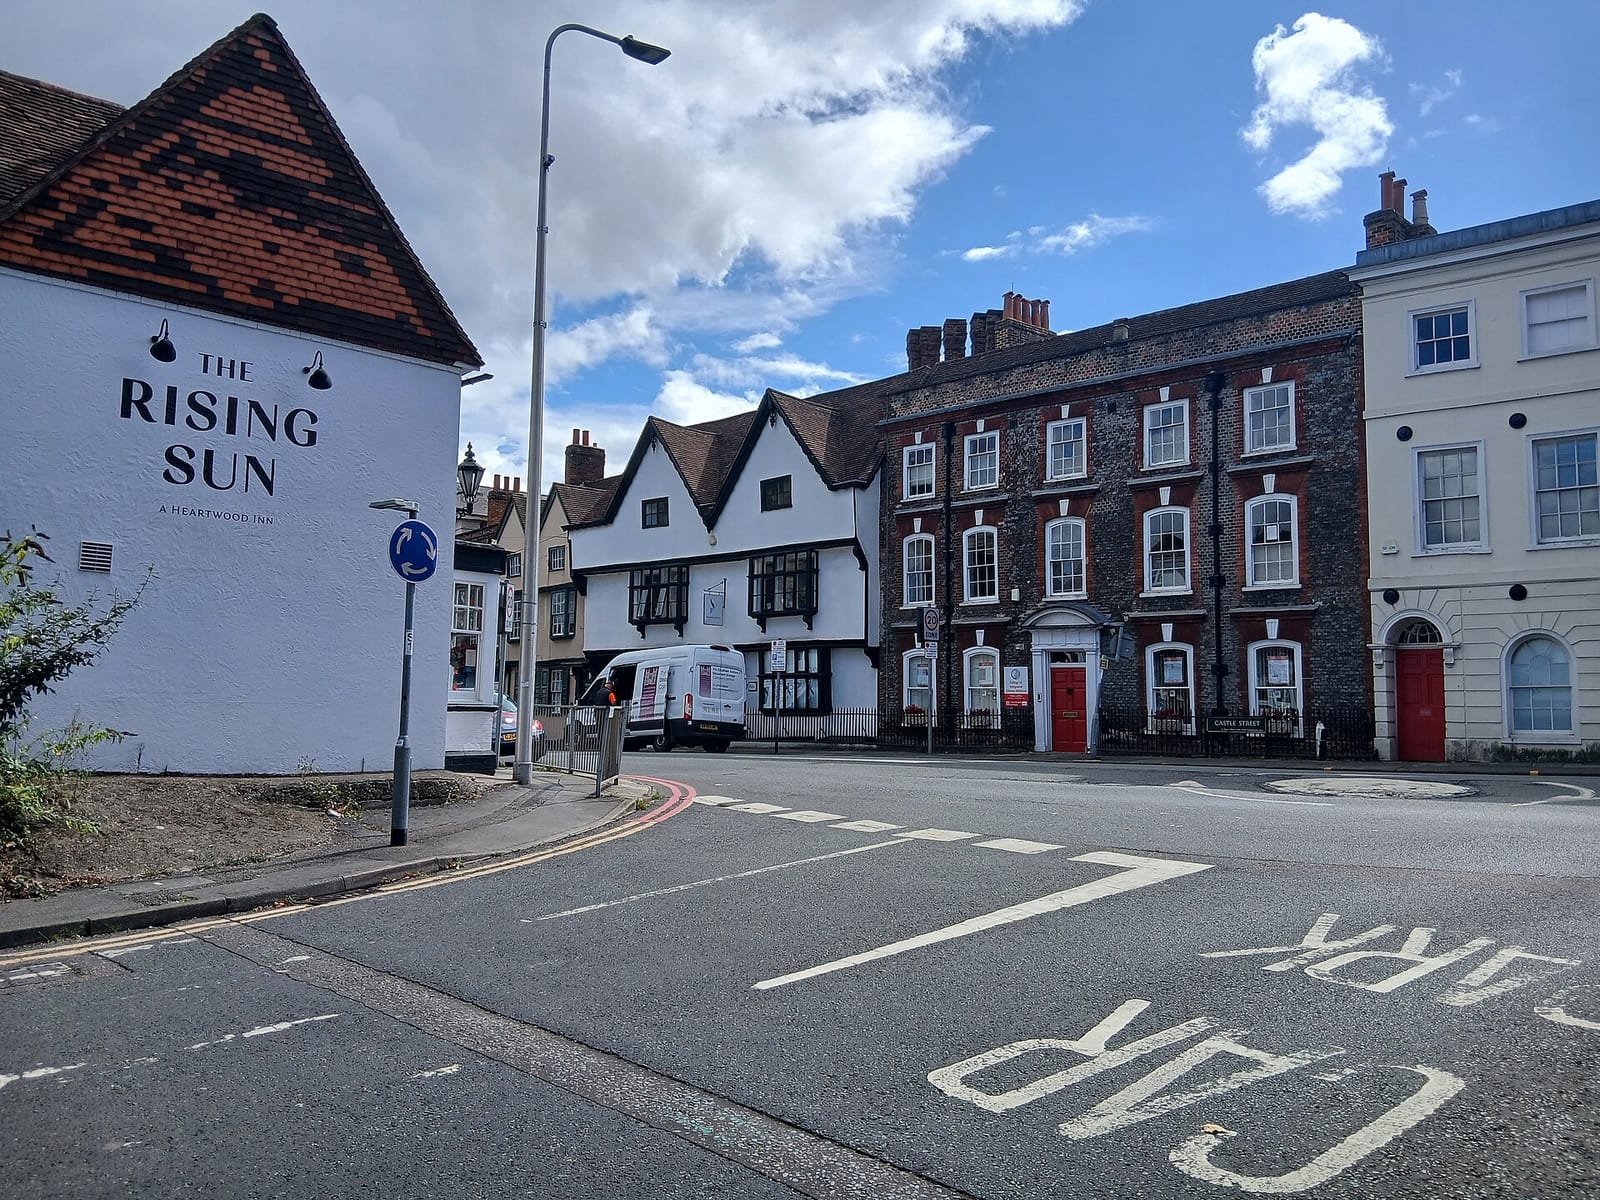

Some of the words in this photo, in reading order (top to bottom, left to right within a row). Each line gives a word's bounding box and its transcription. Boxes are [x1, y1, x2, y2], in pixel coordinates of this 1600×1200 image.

[198, 352, 254, 383] THE
[120, 377, 318, 447] RISING
[162, 444, 276, 497] SUN
[159, 504, 167, 514] A
[171, 505, 249, 523] HEARTWOOD
[252, 513, 274, 525] INN
[927, 615, 936, 625] 20
[925, 631, 938, 639] ZONE
[1214, 719, 1237, 727] CASTLE
[1238, 719, 1260, 727] STREET
[927, 998, 1465, 1194] CAR
